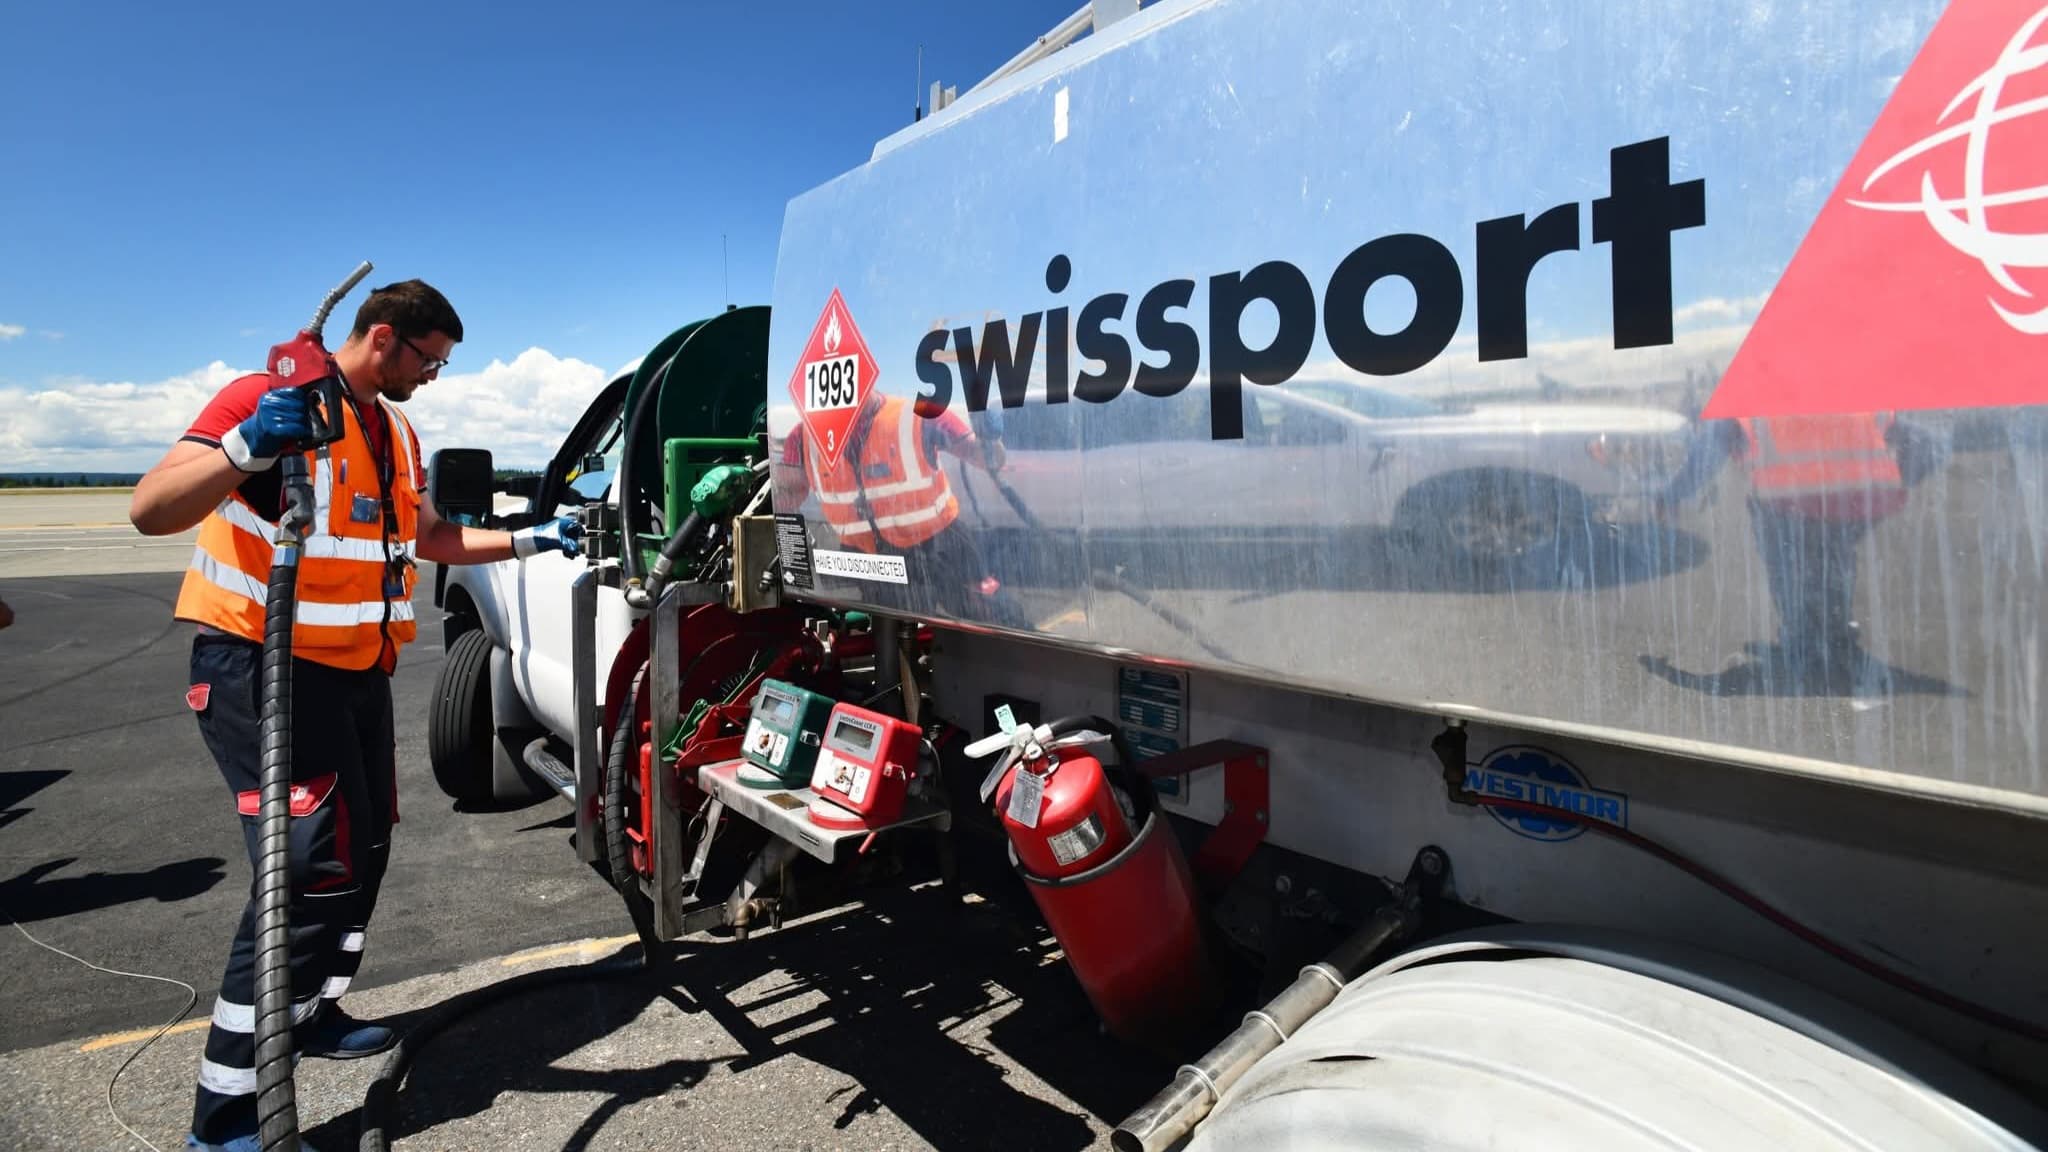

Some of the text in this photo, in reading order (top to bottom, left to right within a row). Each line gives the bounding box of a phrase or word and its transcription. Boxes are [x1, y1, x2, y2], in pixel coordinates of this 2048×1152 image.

[913, 135, 1706, 441] swissport
[808, 358, 855, 408] 1993
[827, 429, 835, 452] 3
[815, 554, 905, 577] HAVE YOU DISCONNECTED
[1464, 769, 1619, 822] WESTMOR
